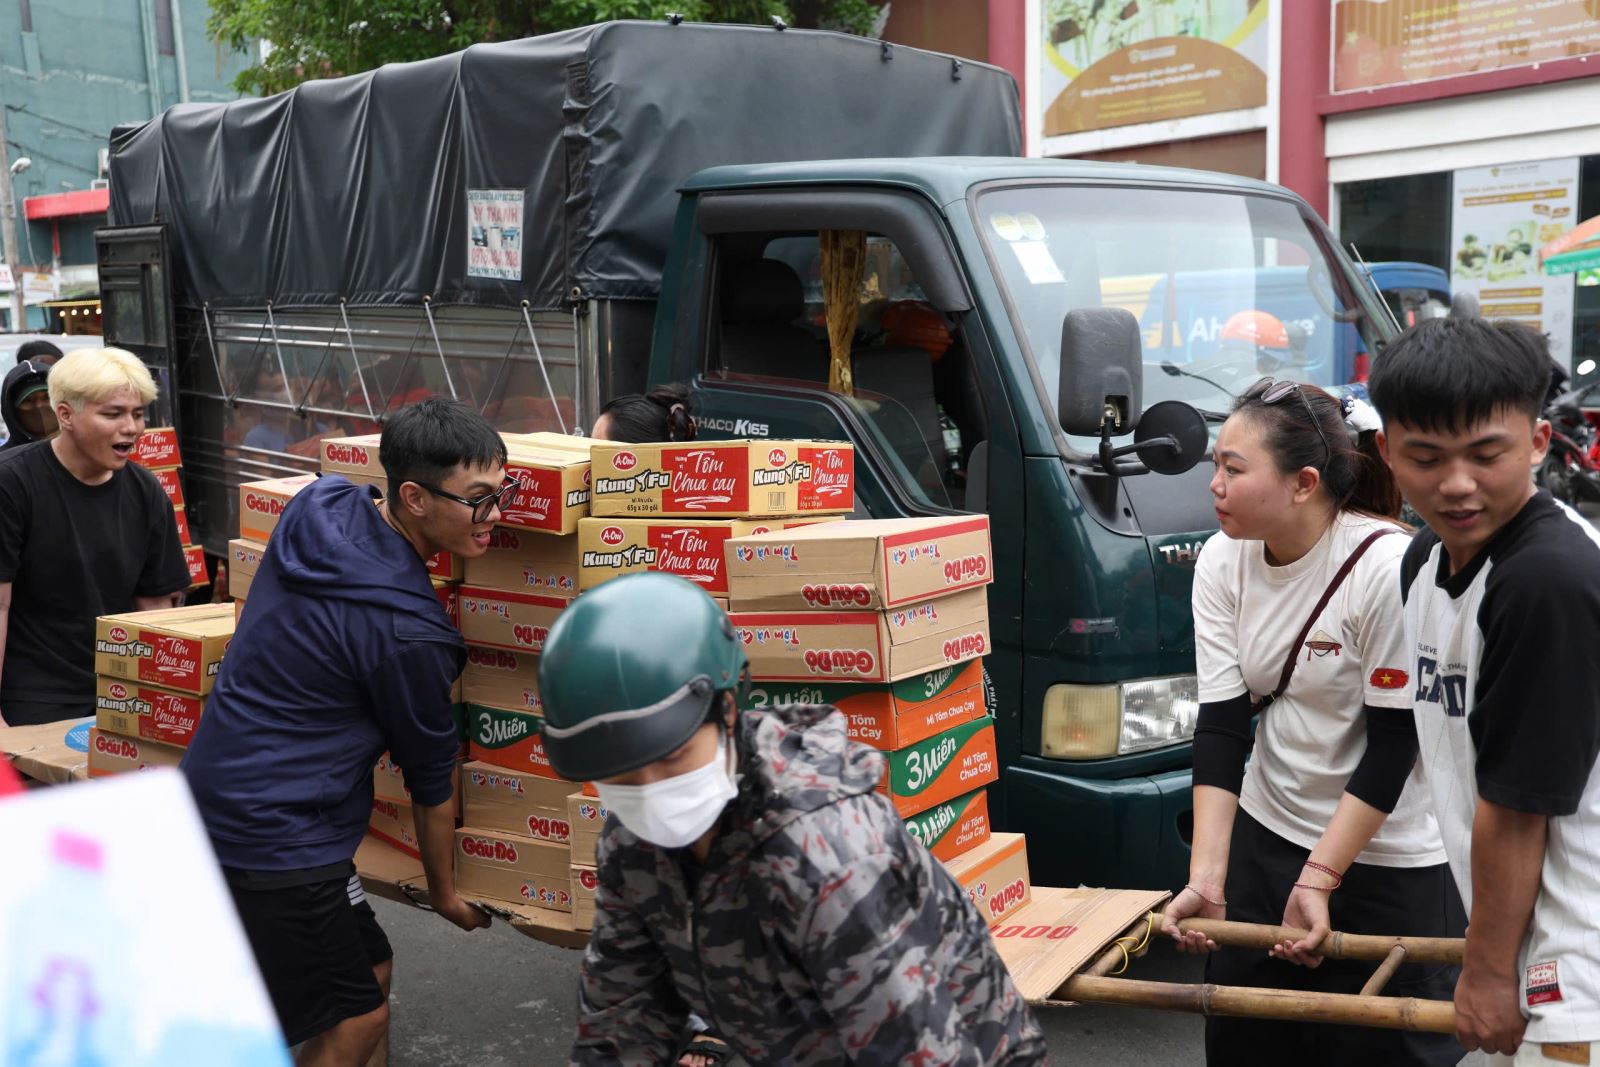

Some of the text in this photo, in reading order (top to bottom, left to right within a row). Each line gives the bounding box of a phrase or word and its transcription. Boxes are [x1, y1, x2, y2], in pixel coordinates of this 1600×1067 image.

[694, 416, 769, 436] HACO K165
[326, 443, 350, 463] Gấu
[688, 451, 723, 474] Tôm
[822, 449, 843, 469] Tôm
[596, 472, 671, 495] Kung Fu
[672, 471, 737, 496] Chua cay
[753, 464, 811, 486] Kung Fu
[813, 467, 850, 486] Chua cay
[246, 493, 270, 513] Gấu
[529, 496, 551, 514] cay
[673, 529, 707, 553] Tôm
[583, 548, 657, 568] Kung Fu
[658, 549, 720, 573] Chua cay
[774, 544, 799, 561] Tôm
[962, 554, 987, 578] Gấu
[831, 584, 872, 608] Gấu
[166, 637, 189, 656] Tôm
[774, 628, 800, 645] Tôm
[961, 632, 985, 657] Gấu
[97, 640, 154, 658] Kung Fu
[155, 650, 178, 666] Chua
[180, 660, 196, 671] cay
[832, 649, 875, 675] Gấu
[924, 673, 934, 697] 3
[97, 696, 152, 715] Kung Fu
[163, 695, 187, 713] Tôm
[479, 712, 493, 744] 3
[850, 714, 876, 725] Tôm
[860, 728, 882, 740] Cay
[95, 735, 121, 755] Gấu
[905, 737, 957, 790] 3 Miền
[972, 751, 988, 764] Tôm
[959, 761, 992, 781] Chua Cay
[550, 819, 570, 840] ấu
[462, 836, 494, 859] Gấu
